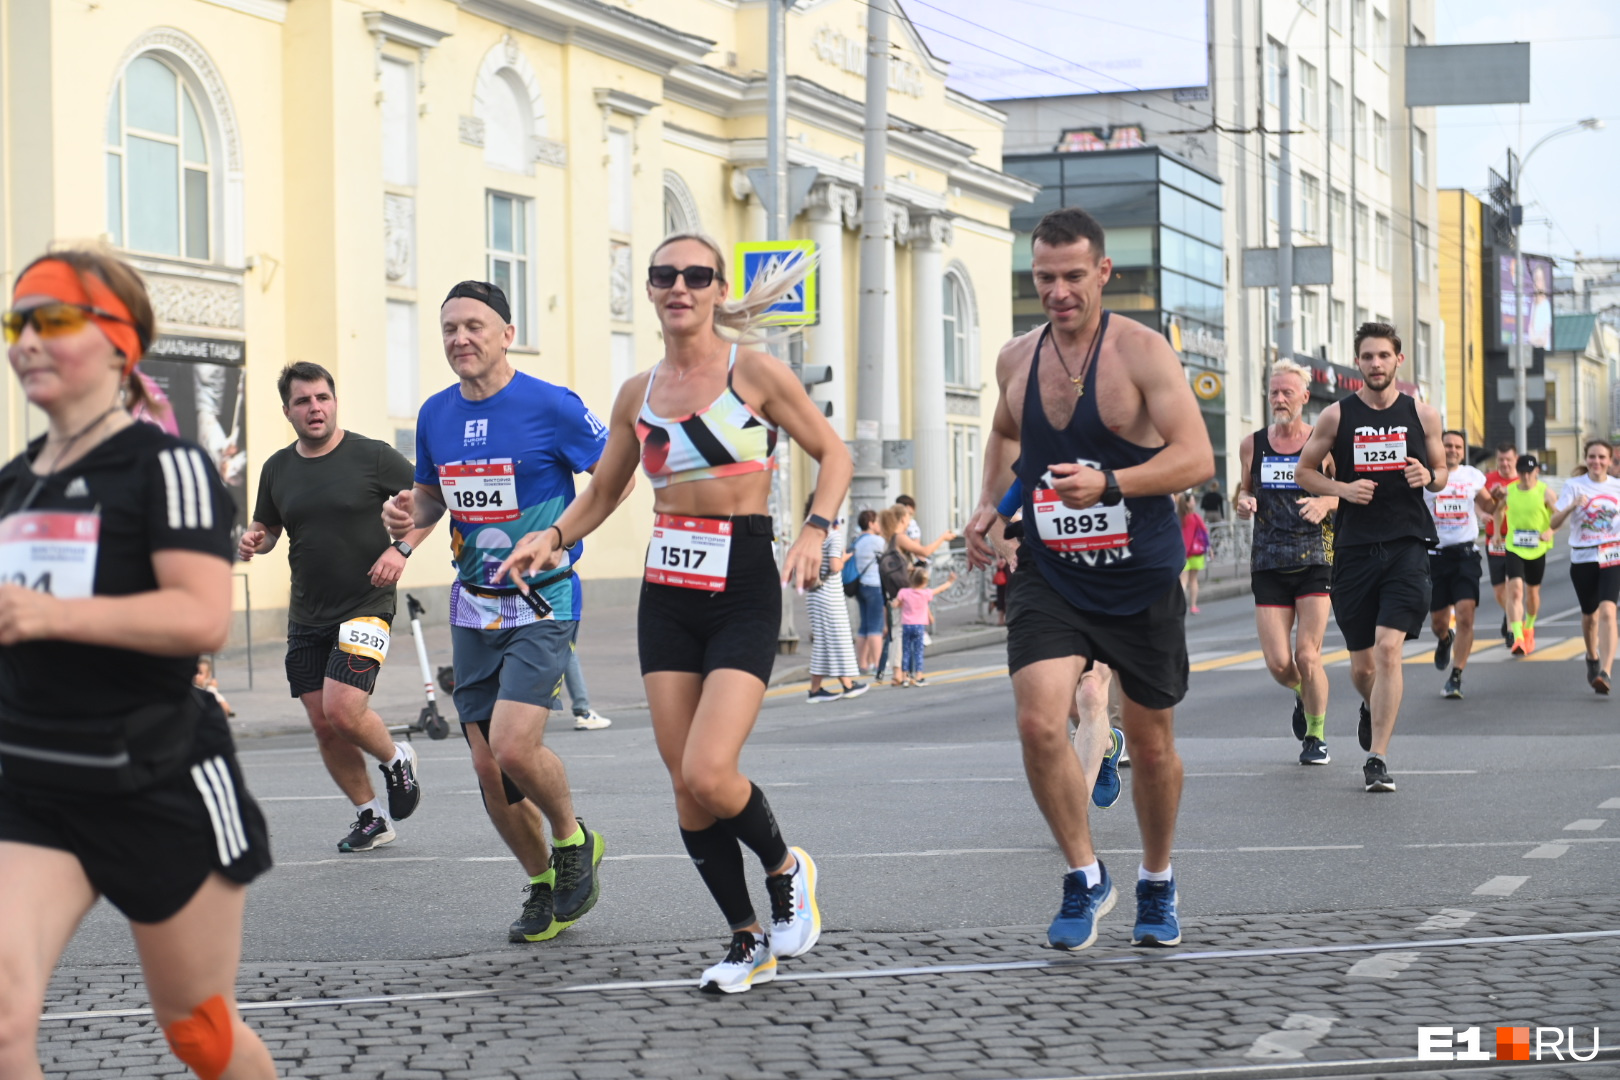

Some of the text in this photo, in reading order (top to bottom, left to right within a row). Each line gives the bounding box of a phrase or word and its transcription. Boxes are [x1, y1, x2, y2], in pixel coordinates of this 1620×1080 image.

[464, 418, 489, 439] EA
[1363, 449, 1398, 463] 1234
[453, 490, 503, 508] 1894
[1052, 513, 1109, 536] 1893
[691, 534, 726, 543] ВИКТОРИЯ
[660, 545, 707, 570] 1517
[349, 629, 385, 651] 5287
